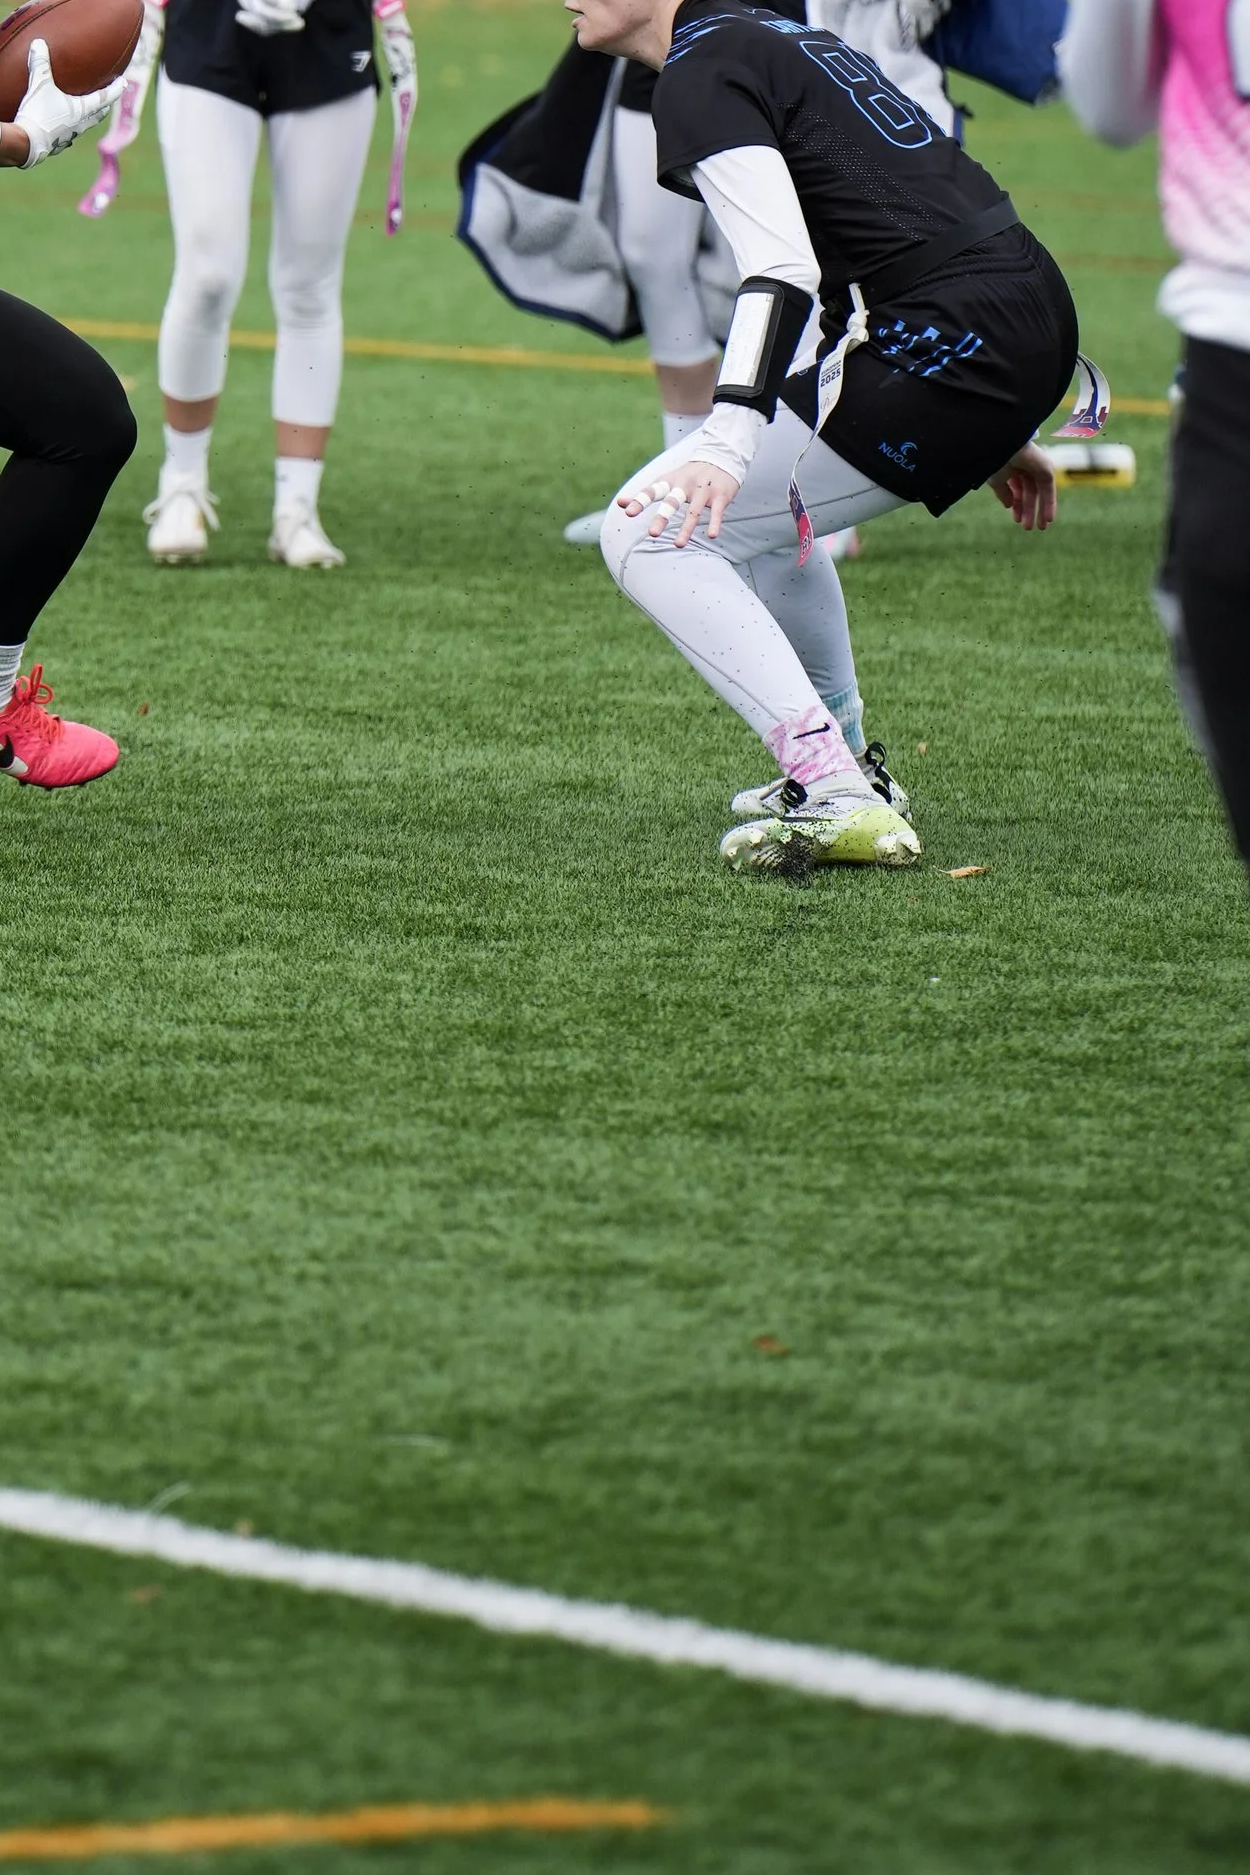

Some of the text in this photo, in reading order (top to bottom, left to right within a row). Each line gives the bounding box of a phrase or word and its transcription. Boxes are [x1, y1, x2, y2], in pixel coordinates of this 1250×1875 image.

[800, 40, 947, 148] 8
[820, 367, 841, 388] 2025
[878, 442, 916, 473] NUOLA
